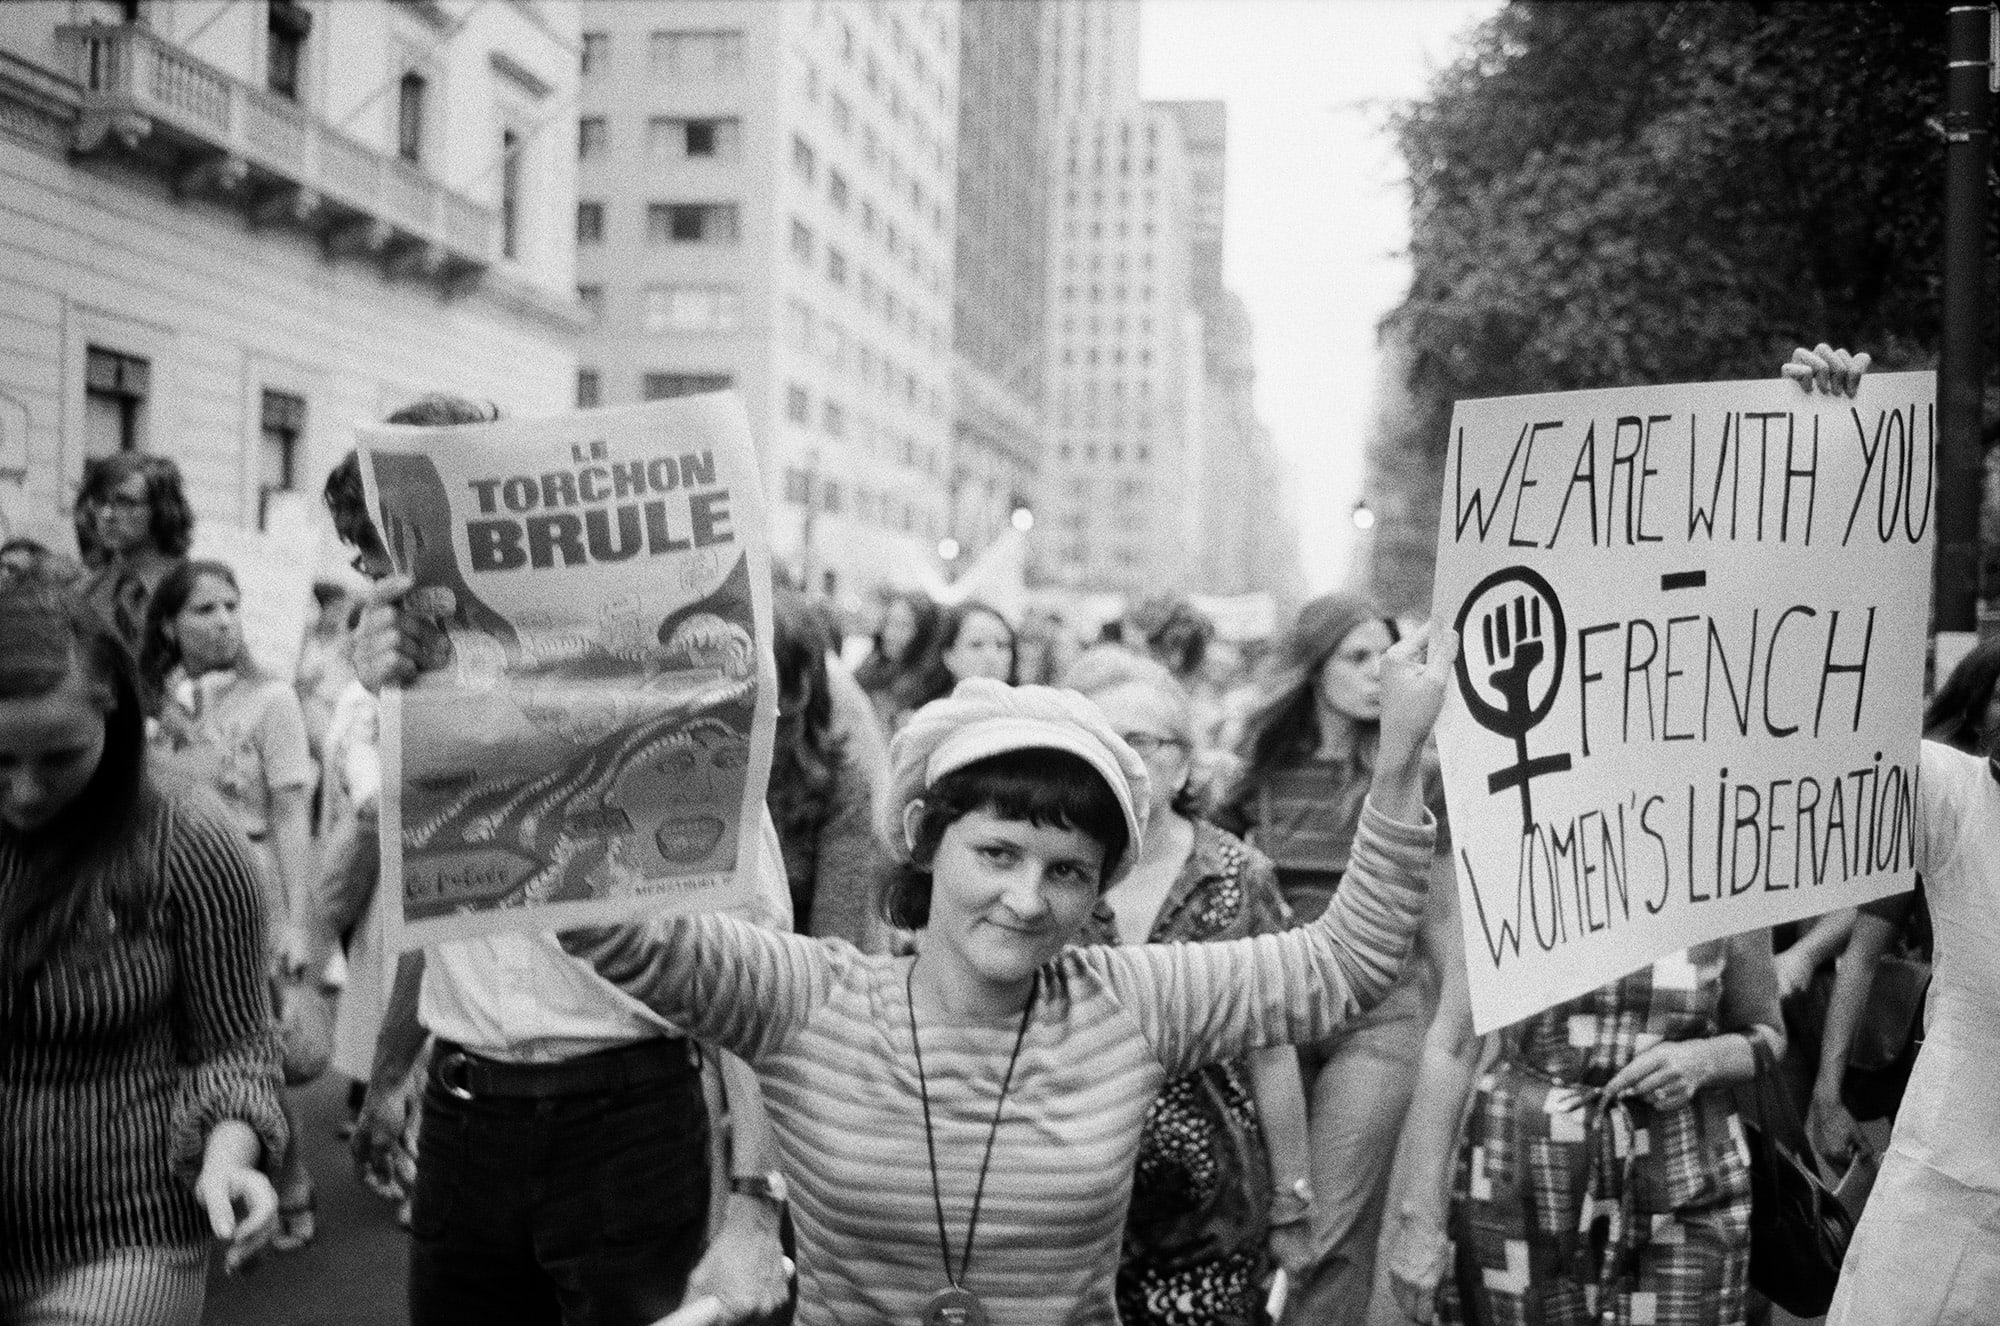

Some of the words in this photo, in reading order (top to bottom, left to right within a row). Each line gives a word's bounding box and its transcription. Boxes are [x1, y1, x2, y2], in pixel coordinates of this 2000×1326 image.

[467, 449, 717, 514] TORCHON
[571, 441, 609, 463] LE
[1687, 410, 1820, 547] WITH
[1843, 402, 1935, 547] YOU
[466, 490, 735, 573] BRULE
[1577, 605, 1878, 757] FRENCH
[1461, 791, 1670, 970] WOMEN'S
